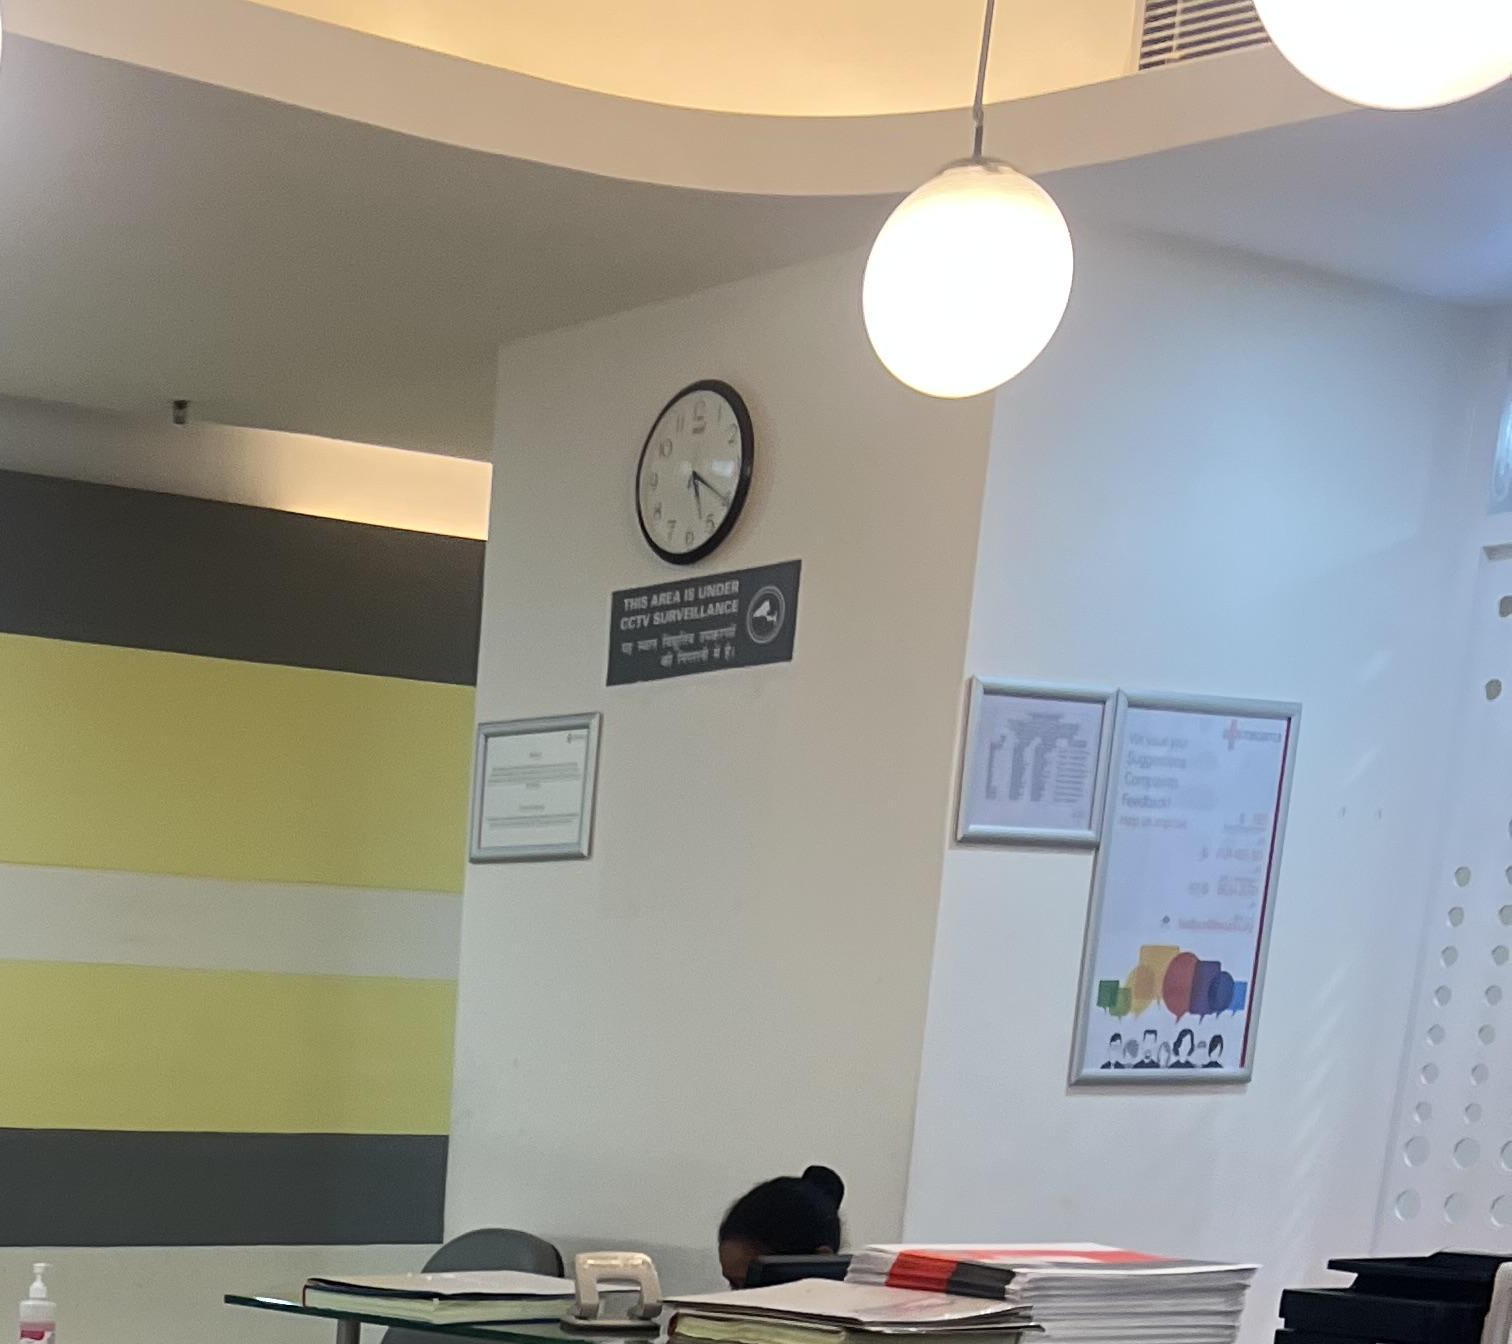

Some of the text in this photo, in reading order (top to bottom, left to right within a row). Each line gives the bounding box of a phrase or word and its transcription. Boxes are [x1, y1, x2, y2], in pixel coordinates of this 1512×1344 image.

[623, 580, 740, 611] THIS AREA IS UNDER
[620, 599, 740, 631] CCTV SURVEILLANCE
